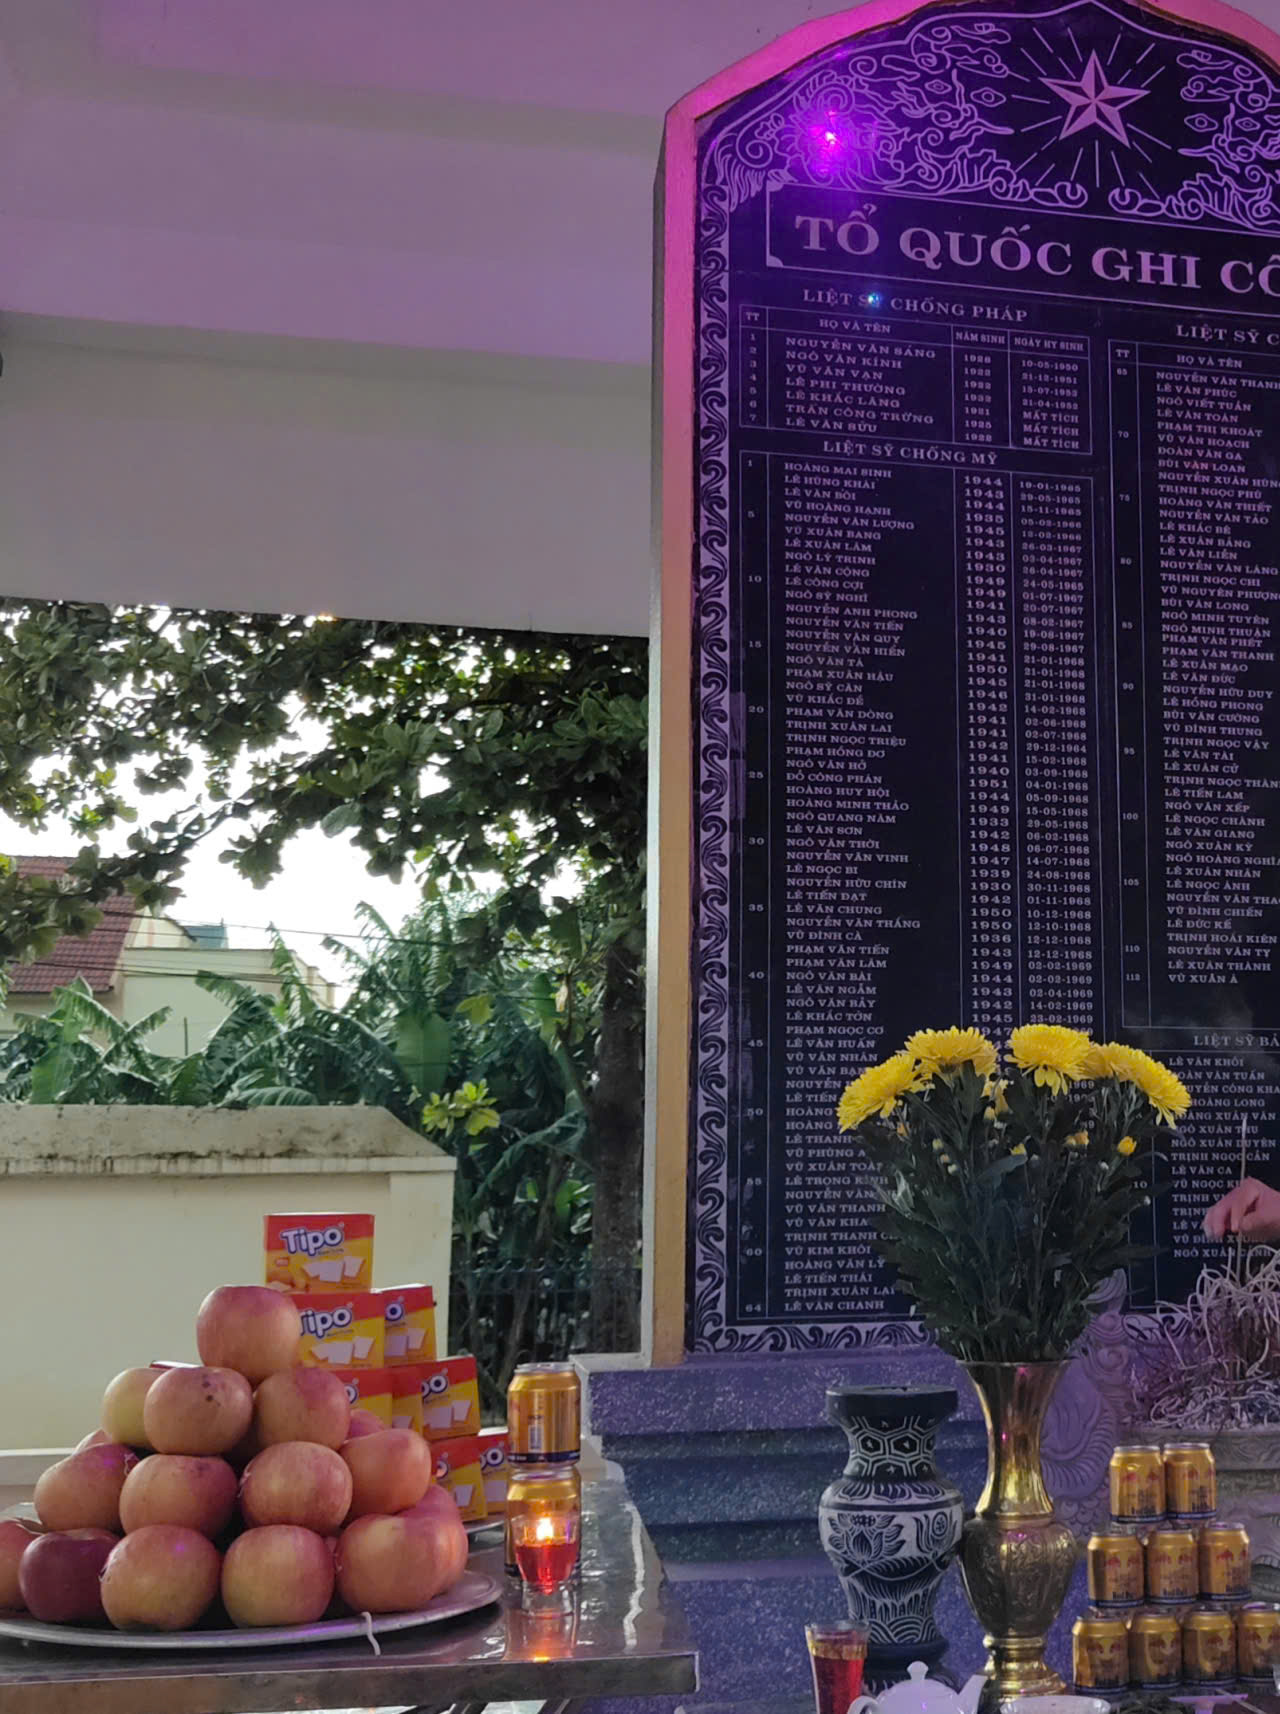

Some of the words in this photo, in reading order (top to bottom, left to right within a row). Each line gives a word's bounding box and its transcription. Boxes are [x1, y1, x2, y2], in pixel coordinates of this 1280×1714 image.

[795, 203, 880, 256] TỔ
[899, 224, 1073, 276] QUỐC
[1091, 247, 1202, 289] GHI
[802, 288, 853, 307] LIỆT
[890, 297, 965, 317] CHỐNG
[972, 305, 1028, 322] PHÁP
[1176, 323, 1228, 342] LIỆT
[823, 440, 867, 456] LIỆT
[899, 445, 967, 463] CHỐNG
[971, 452, 998, 465] MỸ
[833, 465, 857, 475] MAI
[964, 475, 1002, 486] 1944
[748, 574, 762, 583] 10
[843, 606, 871, 616] ANH
[873, 608, 918, 619] PHONG
[1247, 688, 1273, 698] DUY
[748, 704, 765, 713] 20
[870, 722, 892, 733] LAI
[969, 727, 1006, 737] 1941
[968, 740, 1008, 750] 1942
[835, 786, 863, 796] HUY
[969, 791, 1010, 801] 1944
[835, 799, 871, 809] MINH
[969, 804, 1010, 813] 1949
[970, 830, 1010, 839] 1942
[748, 836, 765, 845] 30
[875, 853, 909, 862] VINH
[970, 855, 1009, 865] 1947
[971, 894, 1011, 903] 1942
[748, 902, 764, 911] 35
[836, 904, 882, 914] CHUNG
[971, 907, 1012, 916] 1950
[748, 970, 765, 979] 40
[1193, 1034, 1232, 1049] LIỆT
[1216, 1166, 1233, 1175] CA
[280, 1226, 344, 1257] Tipo
[807, 1246, 834, 1255] KIM
[836, 1301, 885, 1311] CHANH
